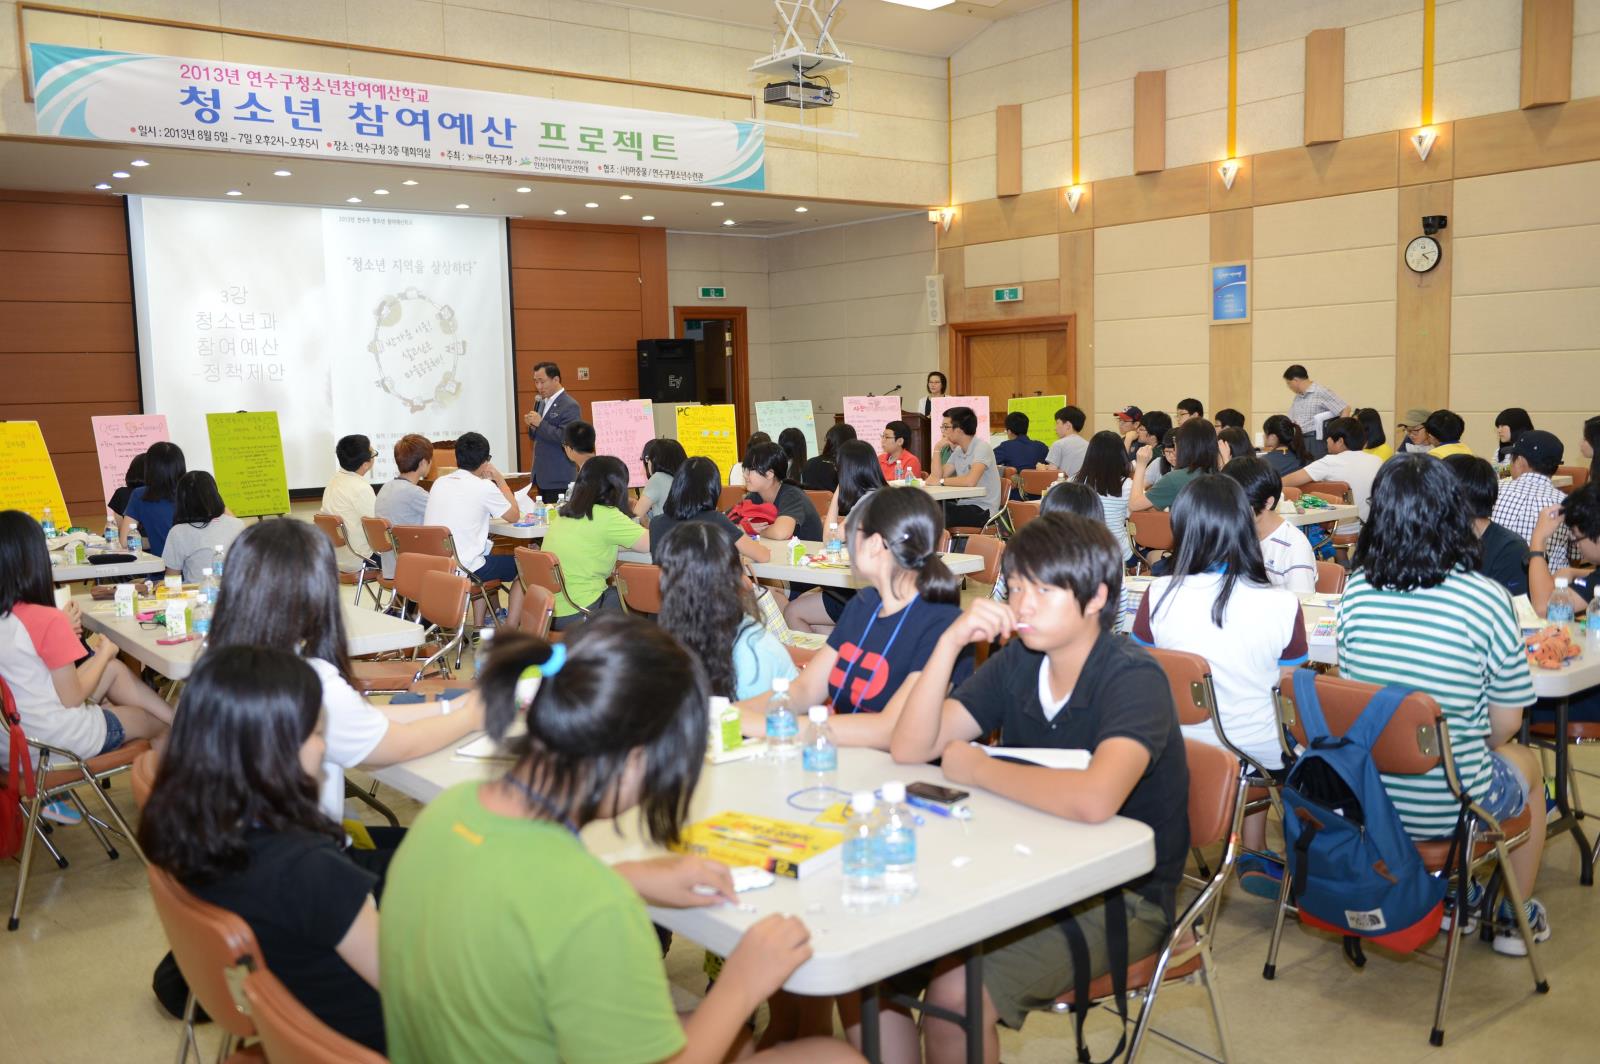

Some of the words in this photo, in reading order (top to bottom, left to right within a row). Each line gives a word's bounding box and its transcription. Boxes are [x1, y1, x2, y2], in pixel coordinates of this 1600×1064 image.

[180, 63, 241, 86] 2013년
[246, 69, 430, 103] 연수구청소년참여예산학교
[179, 86, 323, 132] 청소년
[348, 101, 517, 149] 참여예산
[538, 121, 679, 161] 프로젝트
[164, 127, 195, 141] 2013년
[197, 130, 212, 142] 8월
[213, 131, 228, 143] 5일
[238, 133, 252, 144] 7일
[254, 134, 319, 150] 오후2시~오후5시
[355, 142, 386, 156] 연수구청
[387, 144, 400, 156] 3층
[401, 146, 431, 160] 대회의실
[484, 153, 512, 166] 연수구청
[392, 258, 425, 274] 지역을
[220, 285, 249, 305] 3강
[195, 311, 279, 332] 청소년과
[197, 335, 280, 357] 참여예산
